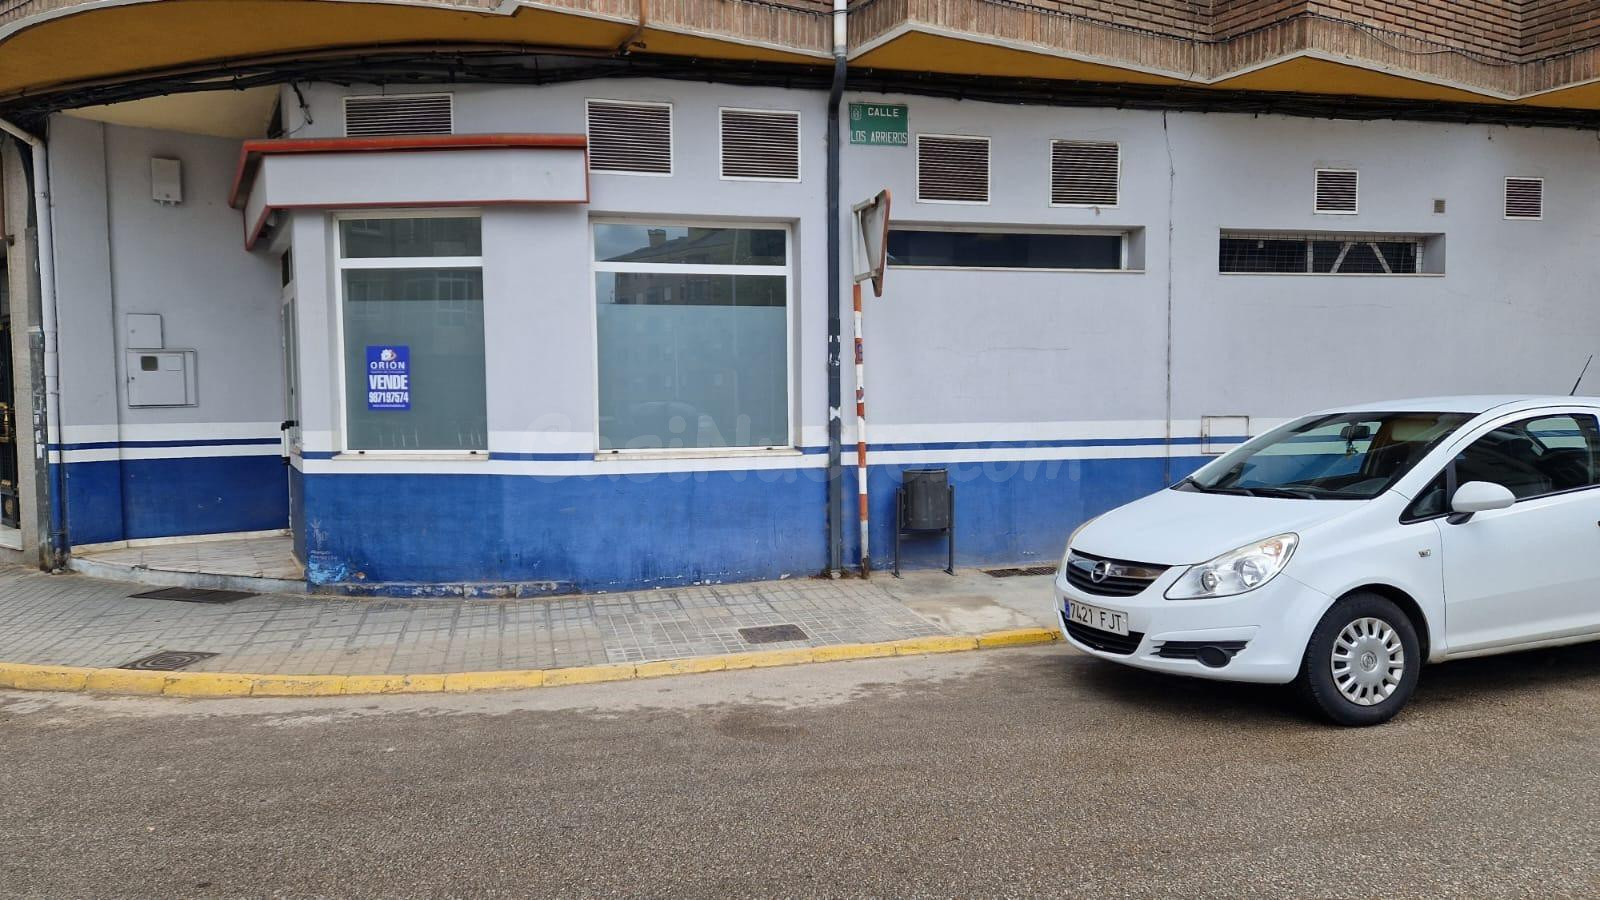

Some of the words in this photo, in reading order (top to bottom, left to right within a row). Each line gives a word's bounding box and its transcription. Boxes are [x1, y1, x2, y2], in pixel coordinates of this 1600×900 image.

[867, 107, 900, 118] CALLE
[850, 130, 867, 143] LOS
[870, 131, 908, 144] ARRIEROS
[369, 360, 406, 370] ORIÓN
[368, 374, 409, 390] VENDE
[368, 391, 409, 403] 987197574
[1070, 602, 1094, 625] 7421
[1099, 611, 1122, 632] FJT
